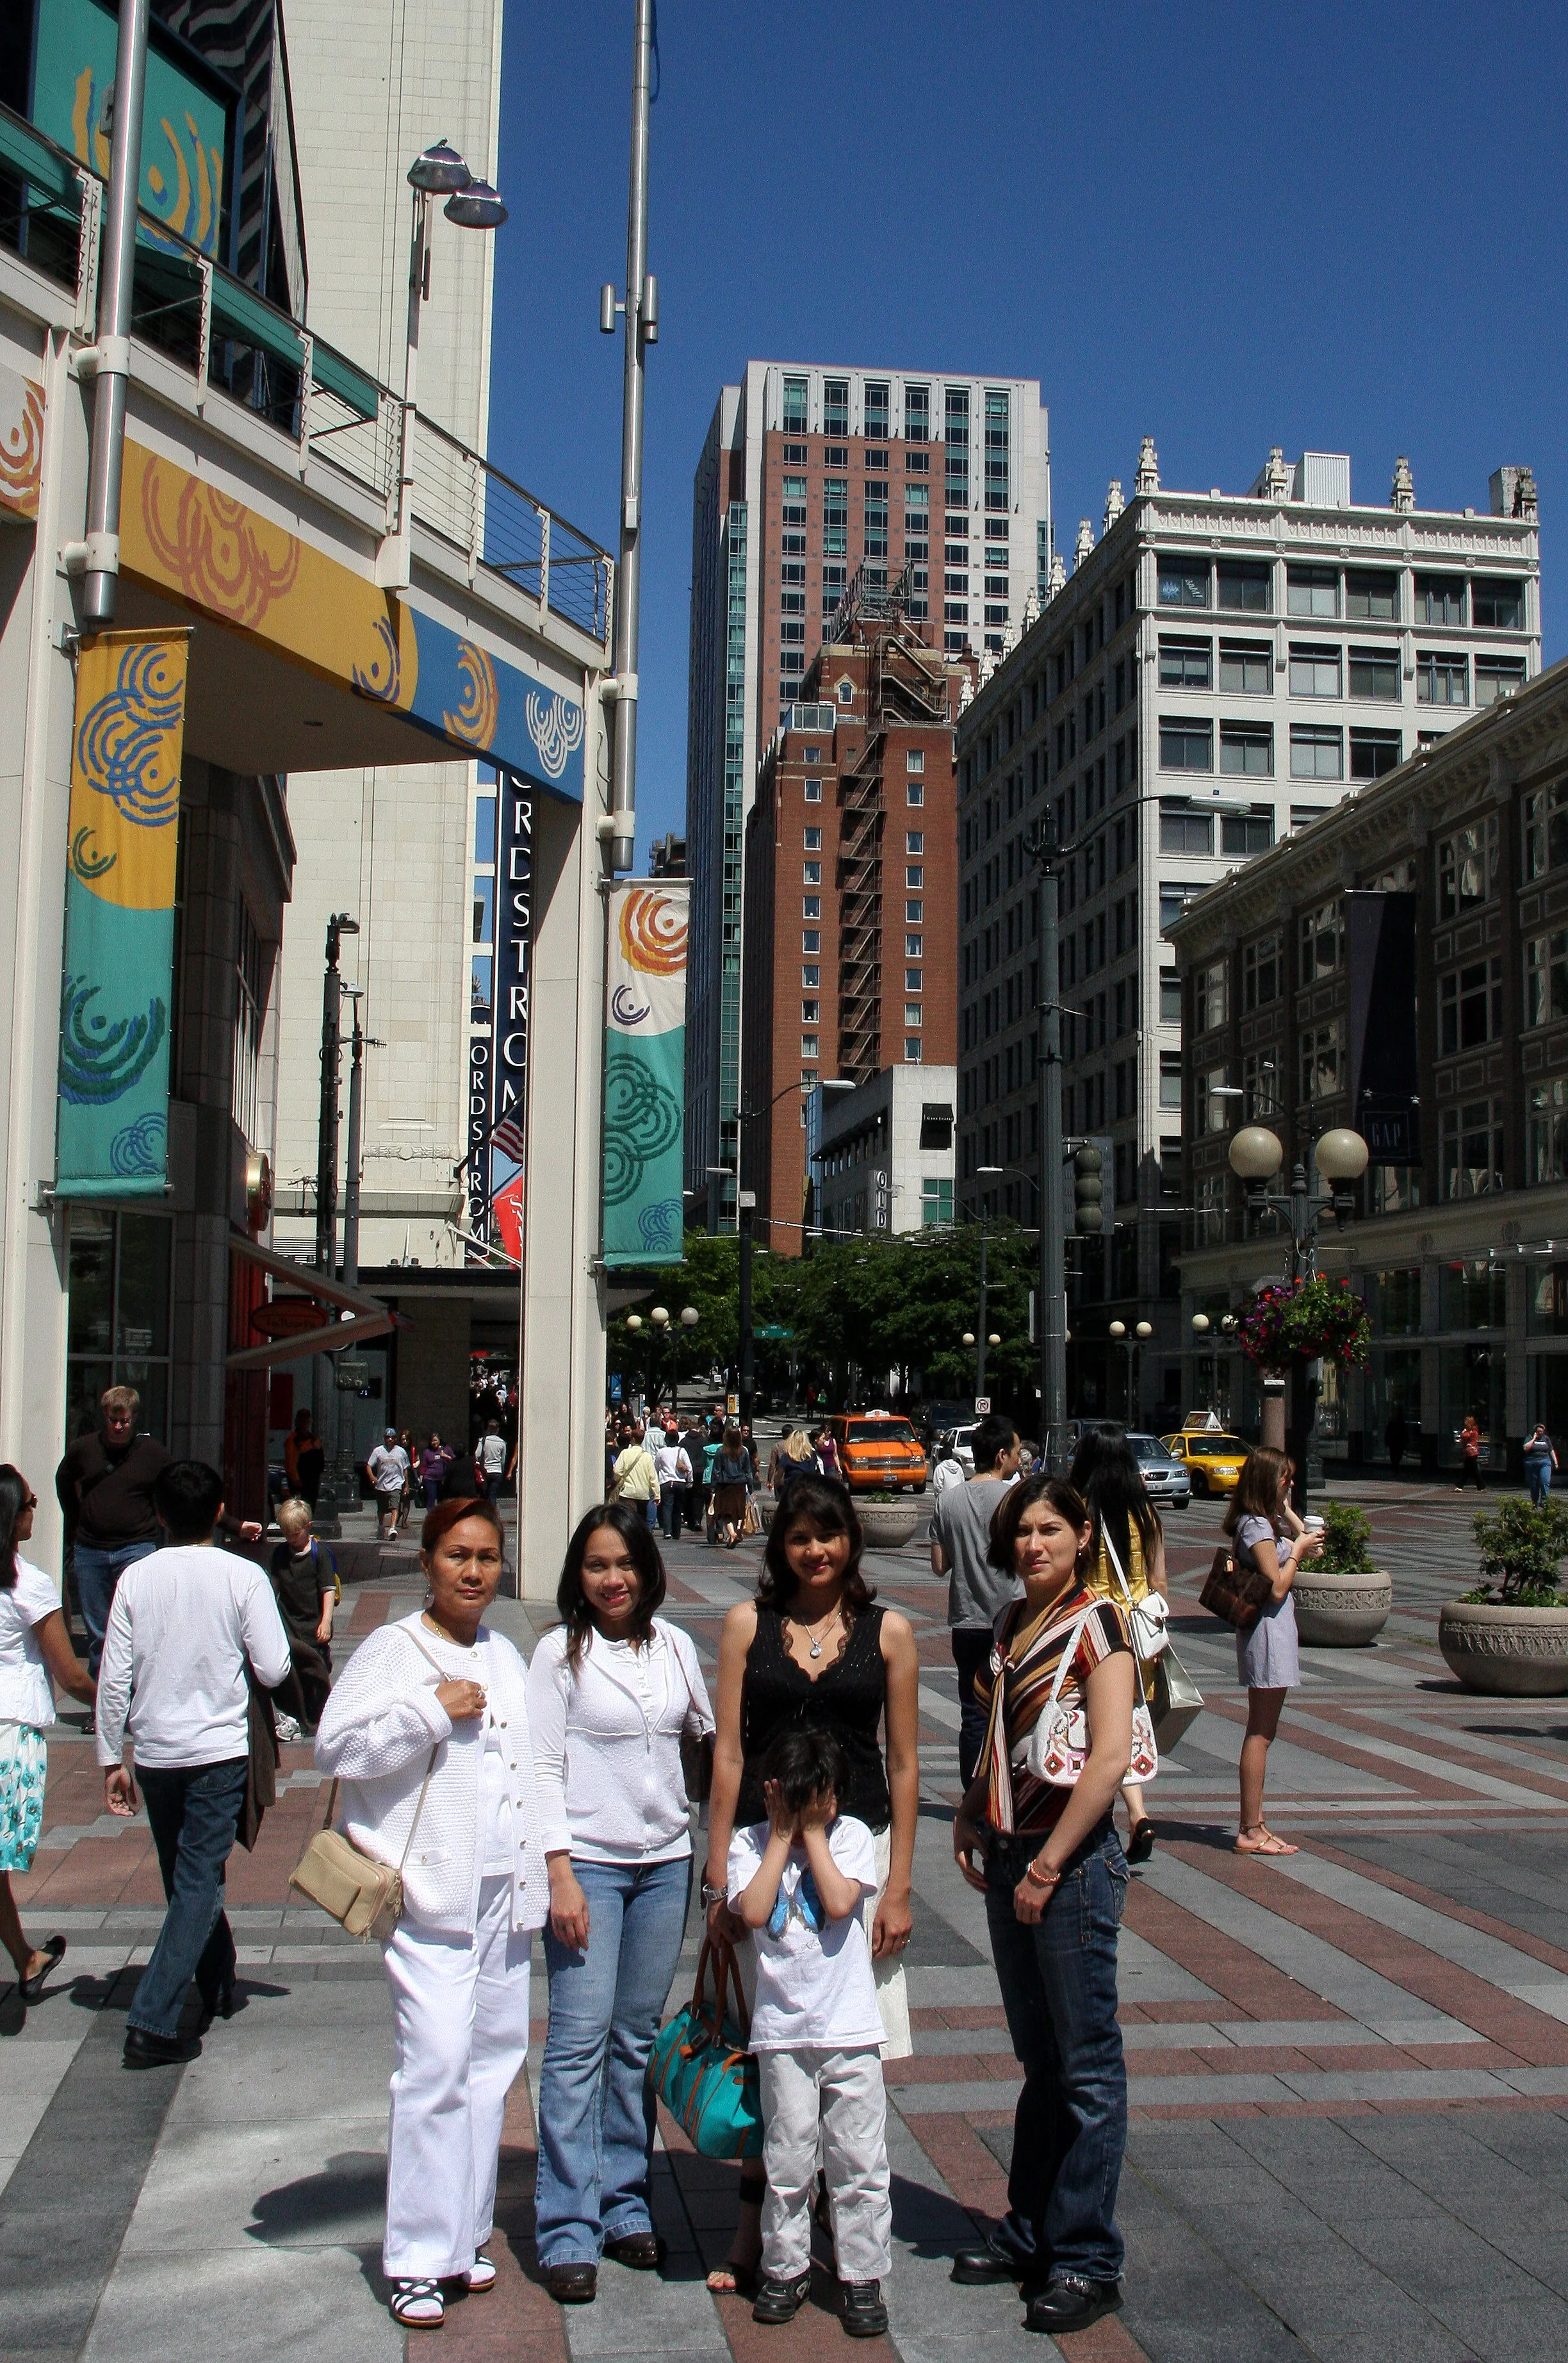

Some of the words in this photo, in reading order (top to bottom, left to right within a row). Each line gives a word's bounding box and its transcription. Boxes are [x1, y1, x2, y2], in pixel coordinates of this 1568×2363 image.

[502, 775, 533, 1114] RDSTRO
[469, 1020, 489, 1242] ORDSTROM
[1371, 1122, 1401, 1147] GAP
